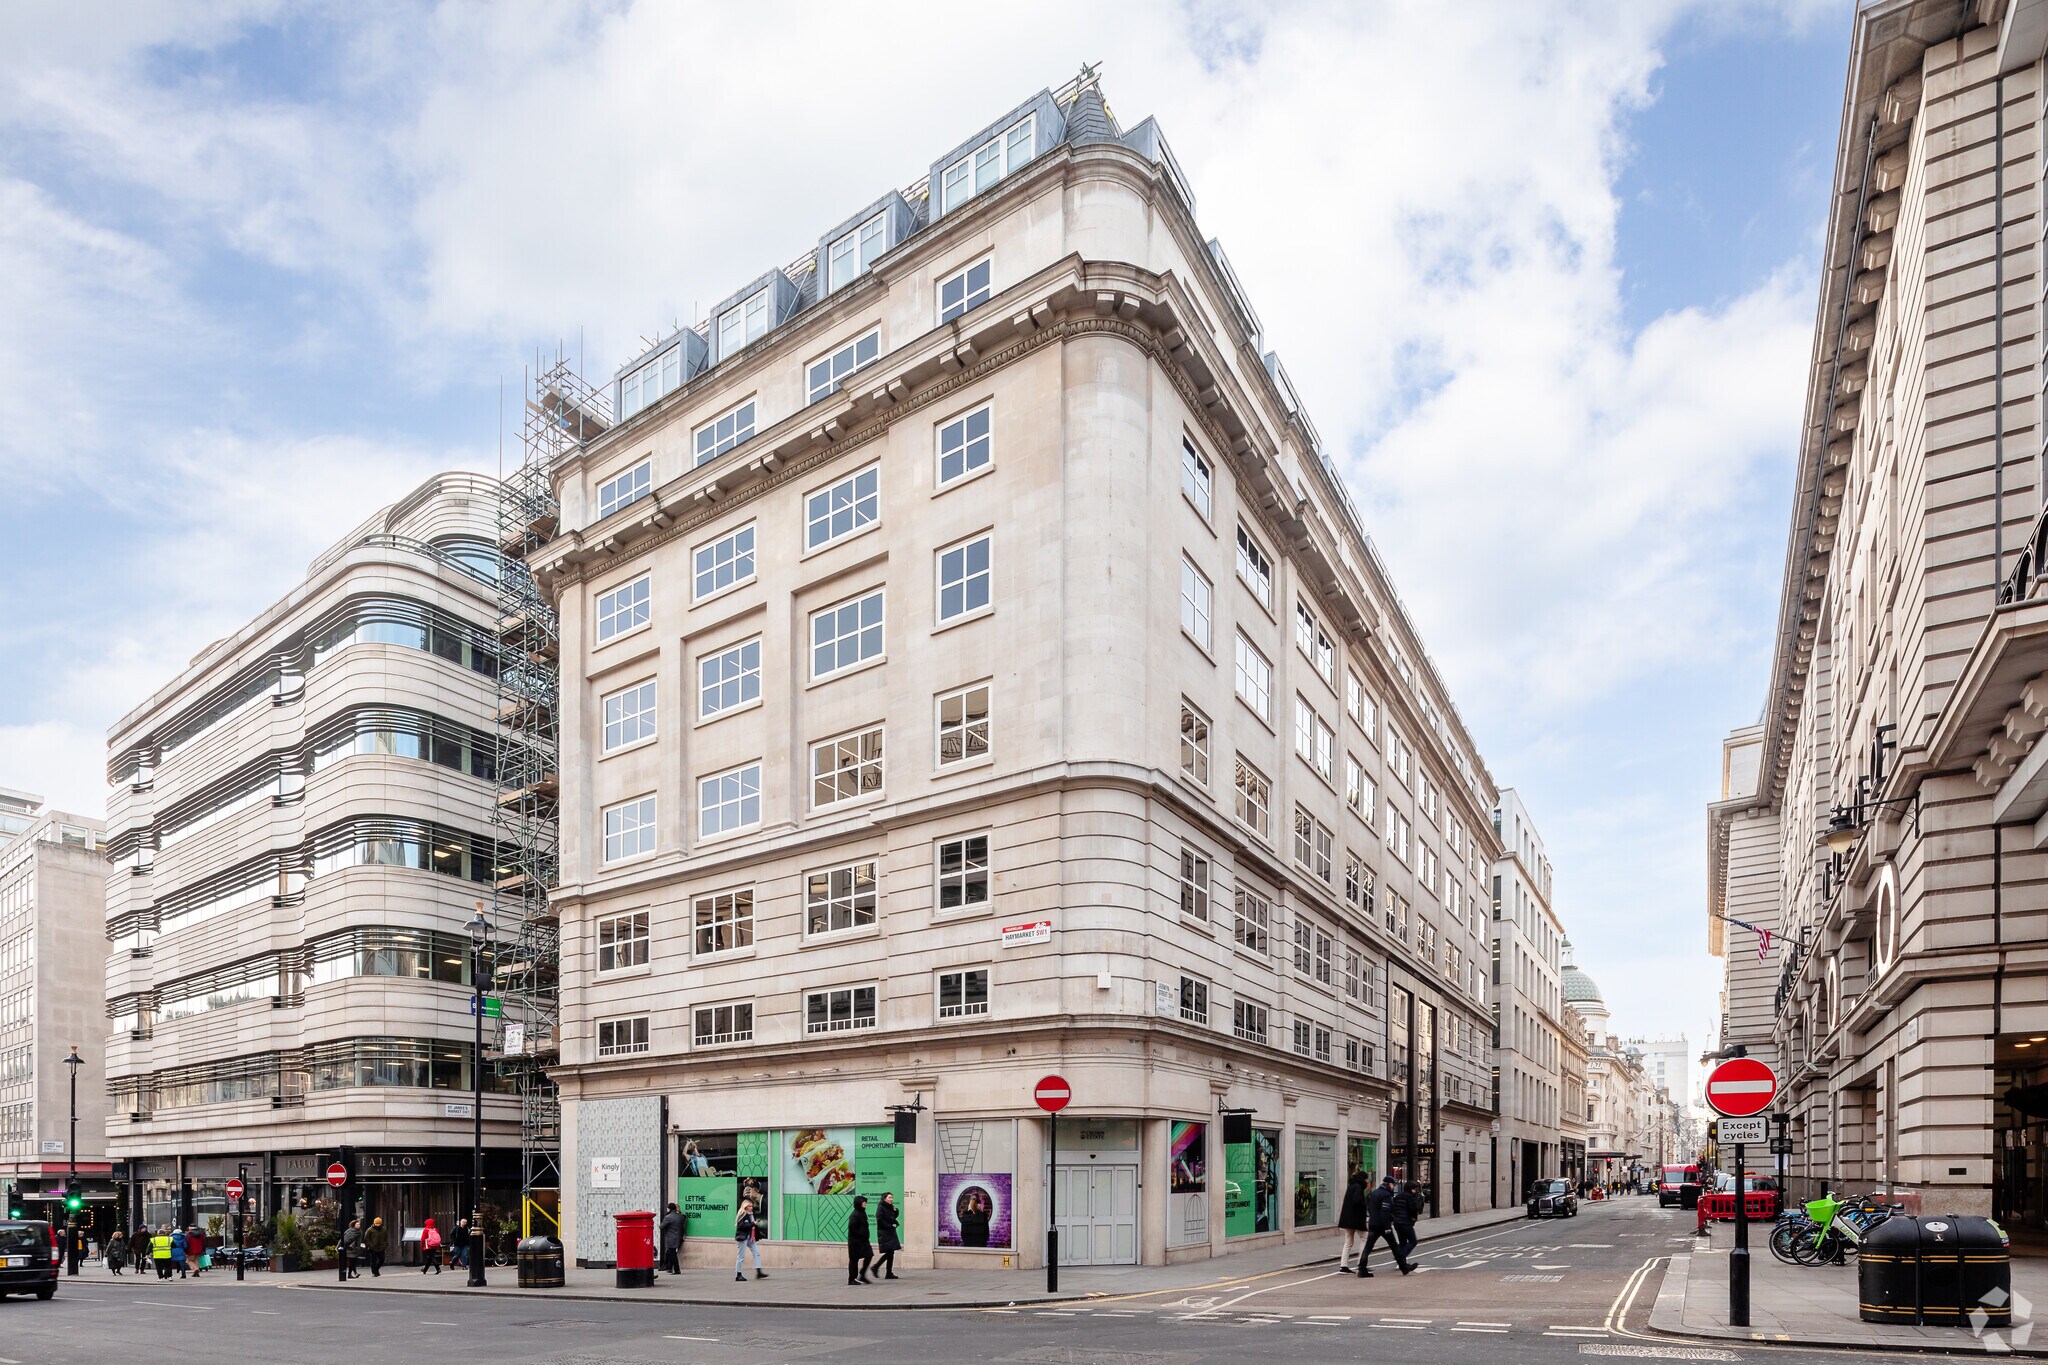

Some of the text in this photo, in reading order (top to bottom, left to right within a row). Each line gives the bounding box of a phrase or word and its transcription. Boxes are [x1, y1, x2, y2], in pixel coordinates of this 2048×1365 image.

[1005, 931, 1035, 940] HAYMARKET
[1722, 1121, 1762, 1130] Except
[1723, 1131, 1760, 1141] cycles
[288, 1160, 315, 1169] FALLO
[362, 1156, 428, 1167] FALLOW
[601, 1163, 620, 1171] Kingly
[685, 1203, 729, 1211] ENTERTAINMENT
[685, 1211, 702, 1219] BEGIN
[1003, 1256, 1010, 1266] H
